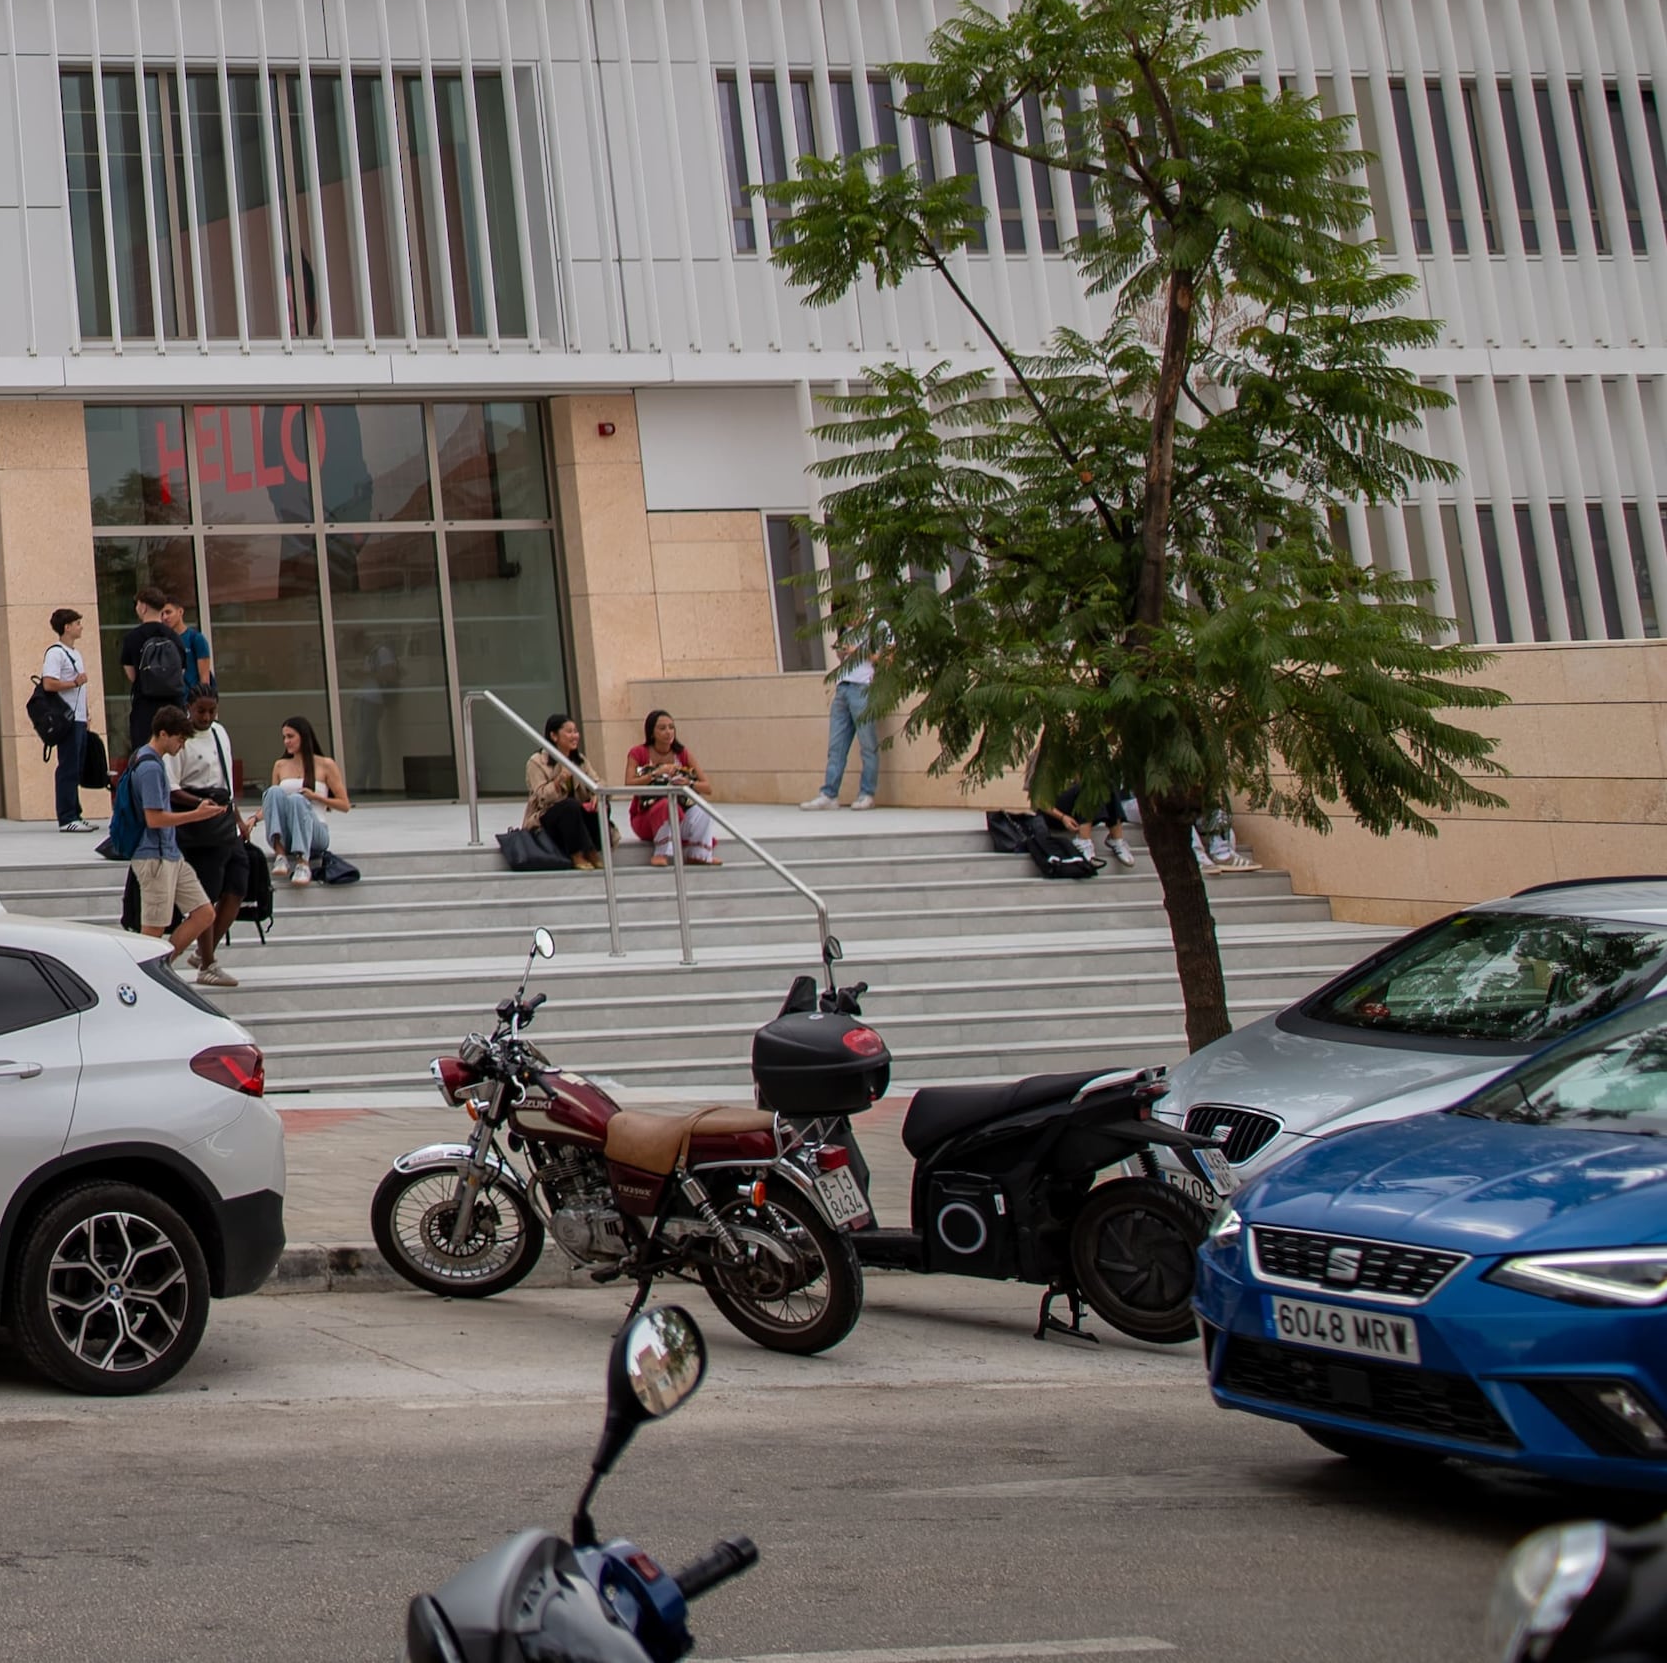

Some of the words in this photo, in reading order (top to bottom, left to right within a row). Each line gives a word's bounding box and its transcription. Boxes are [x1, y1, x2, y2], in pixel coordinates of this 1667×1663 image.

[156, 404, 327, 506] HELLO
[830, 1198, 864, 1220] 8434
[1278, 1303, 1346, 1344] 6048
[1352, 1315, 1408, 1355] MRW
